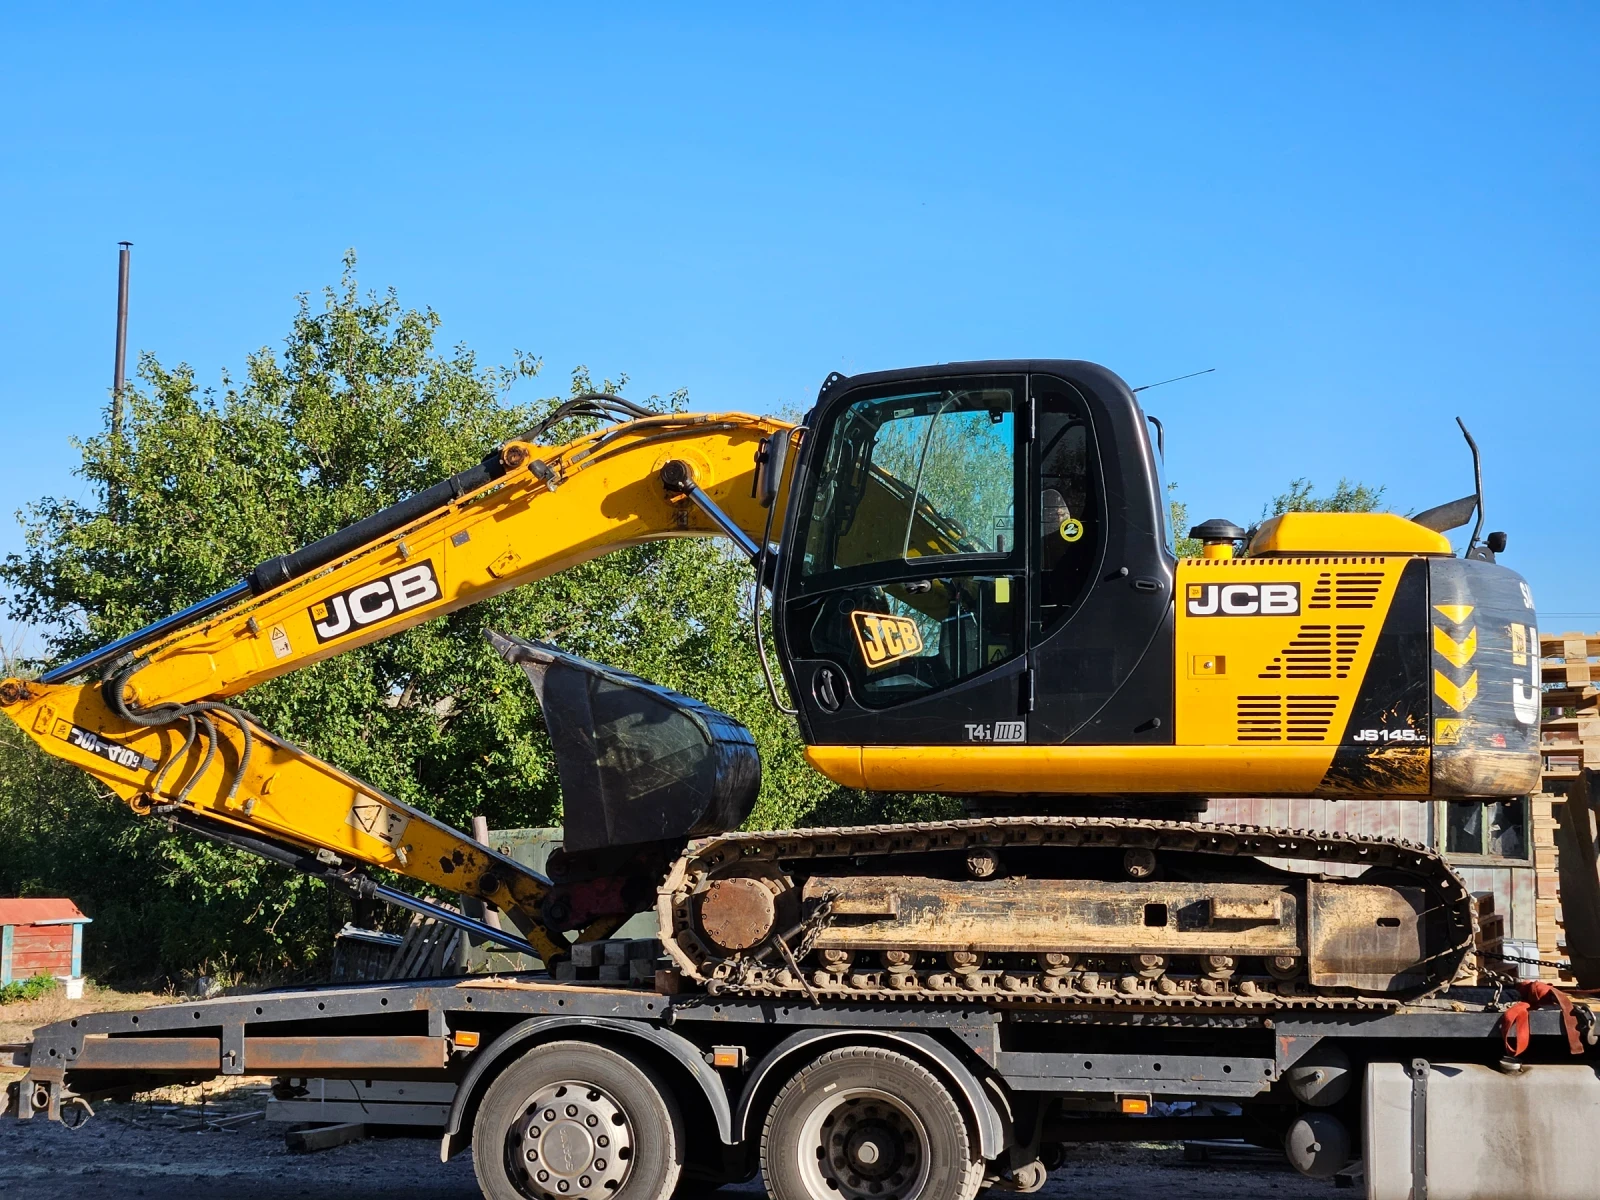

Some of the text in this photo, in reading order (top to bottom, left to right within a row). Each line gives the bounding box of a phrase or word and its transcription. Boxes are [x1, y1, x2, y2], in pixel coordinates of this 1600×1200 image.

[316, 565, 438, 638] JCB
[1188, 584, 1299, 615] JCB
[864, 617, 918, 661] JCB
[964, 724, 993, 741] T4i
